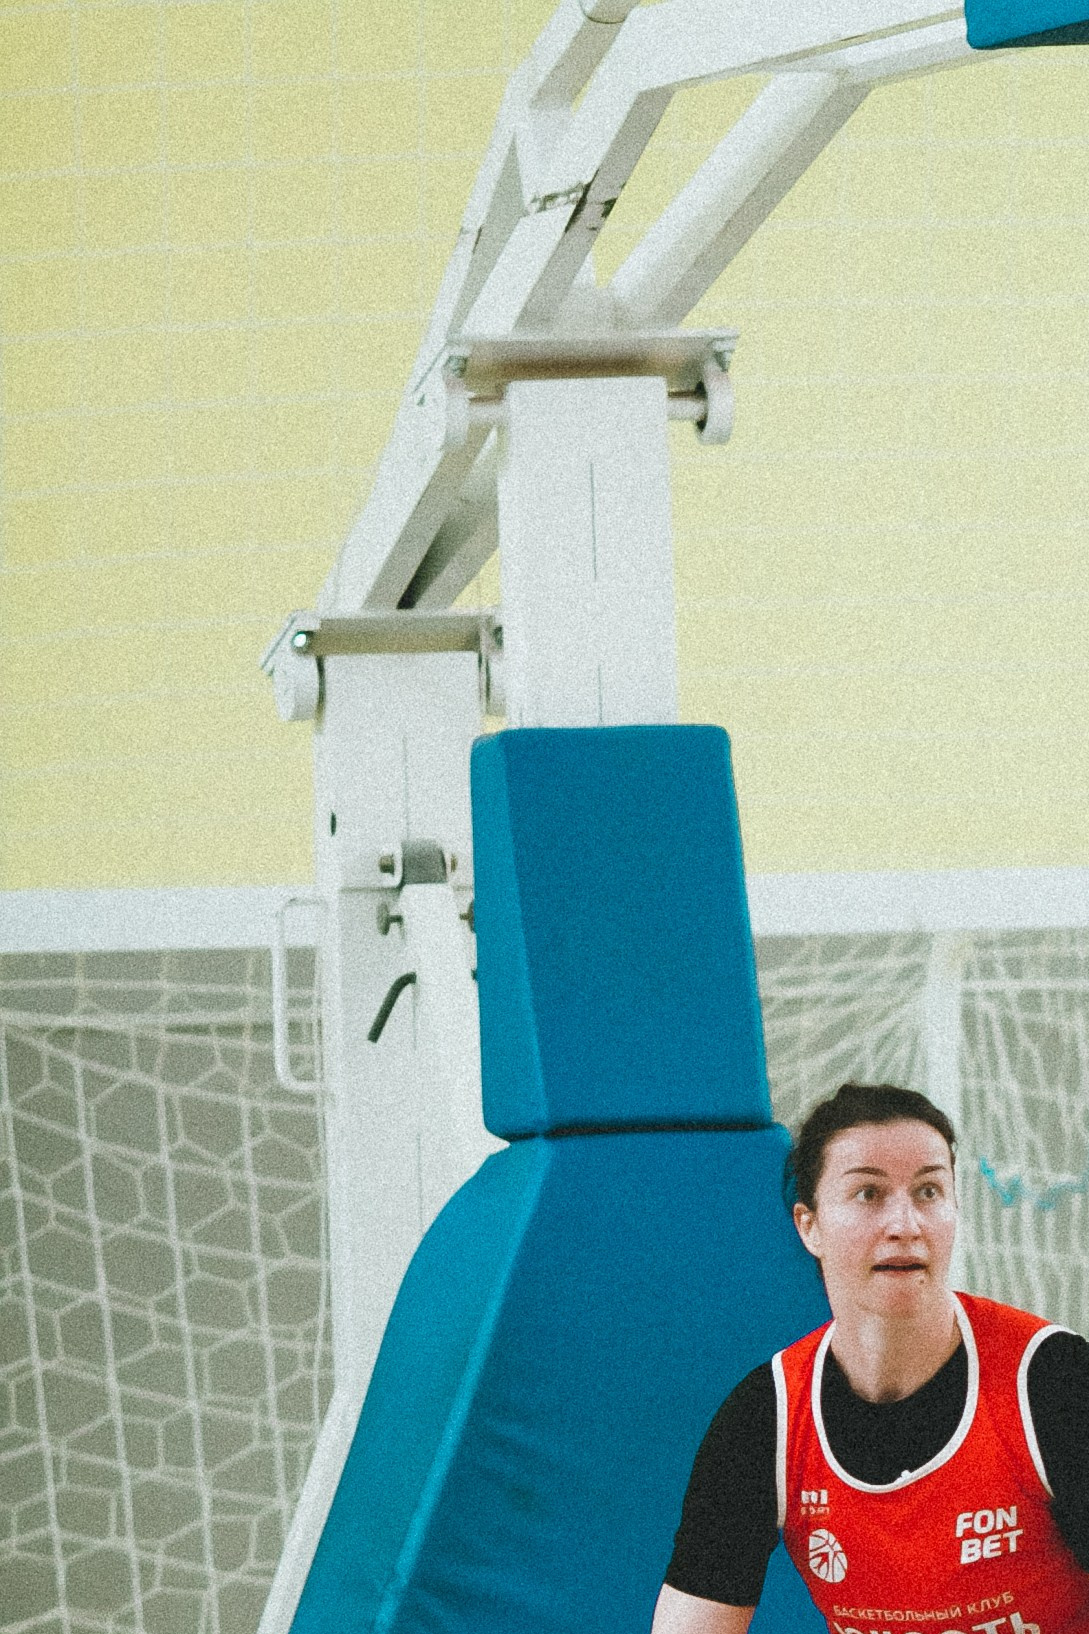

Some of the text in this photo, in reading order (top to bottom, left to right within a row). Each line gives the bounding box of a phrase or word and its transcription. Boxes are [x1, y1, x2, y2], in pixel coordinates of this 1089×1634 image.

[955, 1505, 1018, 1538] FON
[960, 1529, 1023, 1565] BET
[833, 1591, 1014, 1622] БАСКЕТБОЛЬНЫЙ КЛУБ
